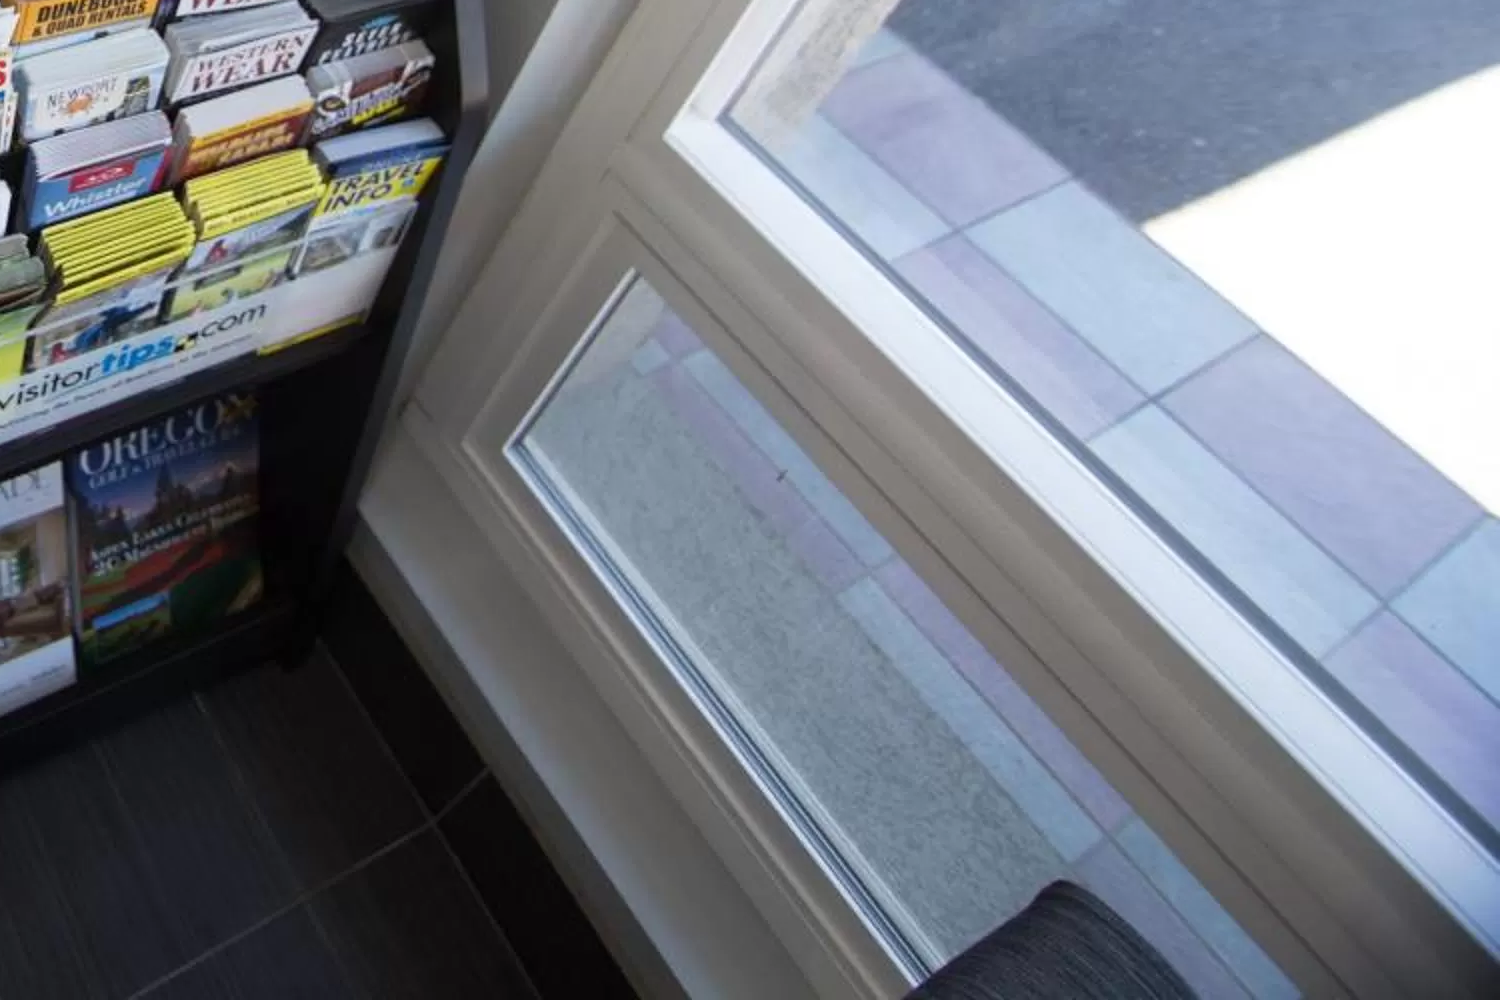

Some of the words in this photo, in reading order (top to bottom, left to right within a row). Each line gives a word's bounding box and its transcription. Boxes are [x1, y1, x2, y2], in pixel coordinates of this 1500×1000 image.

[45, 14, 86, 35] QUAD
[88, 0, 149, 24] RENTALS
[196, 31, 307, 73] WESTERN
[190, 51, 296, 93] WEAR
[331, 161, 424, 194] TRAVEL
[323, 183, 393, 213] INFO
[78, 395, 257, 476] OREGO
